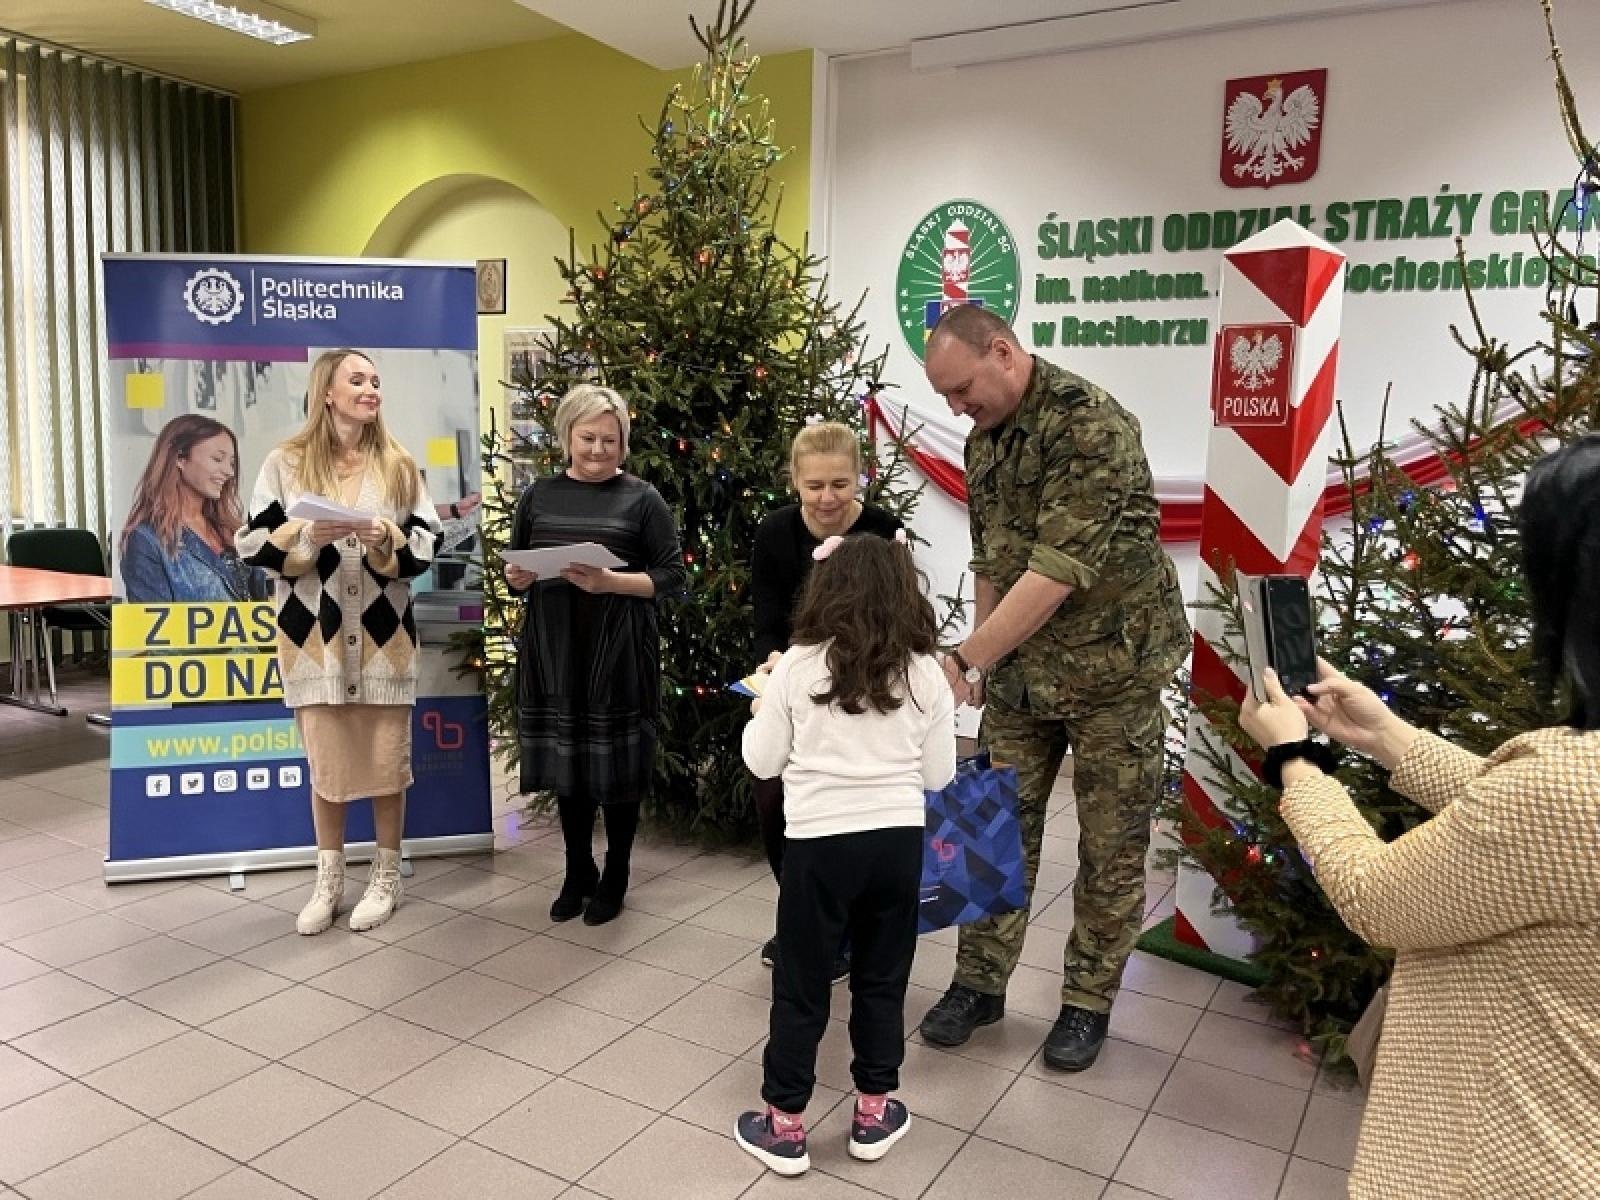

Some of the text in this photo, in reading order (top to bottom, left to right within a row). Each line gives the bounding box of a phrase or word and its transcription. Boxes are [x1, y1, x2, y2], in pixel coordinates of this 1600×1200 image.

[1037, 211, 1153, 264] ŚLĄSKI
[1325, 184, 1482, 243] STRAŻY
[261, 277, 405, 301] Politechnika
[1035, 273, 1077, 305] im.
[1082, 269, 1209, 303] nadkom.
[262, 296, 338, 321] Śląska
[1032, 315, 1209, 347] w Raciborzu
[1223, 397, 1280, 417] POLSKA
[143, 607, 171, 647] Z
[145, 660, 207, 700] DO
